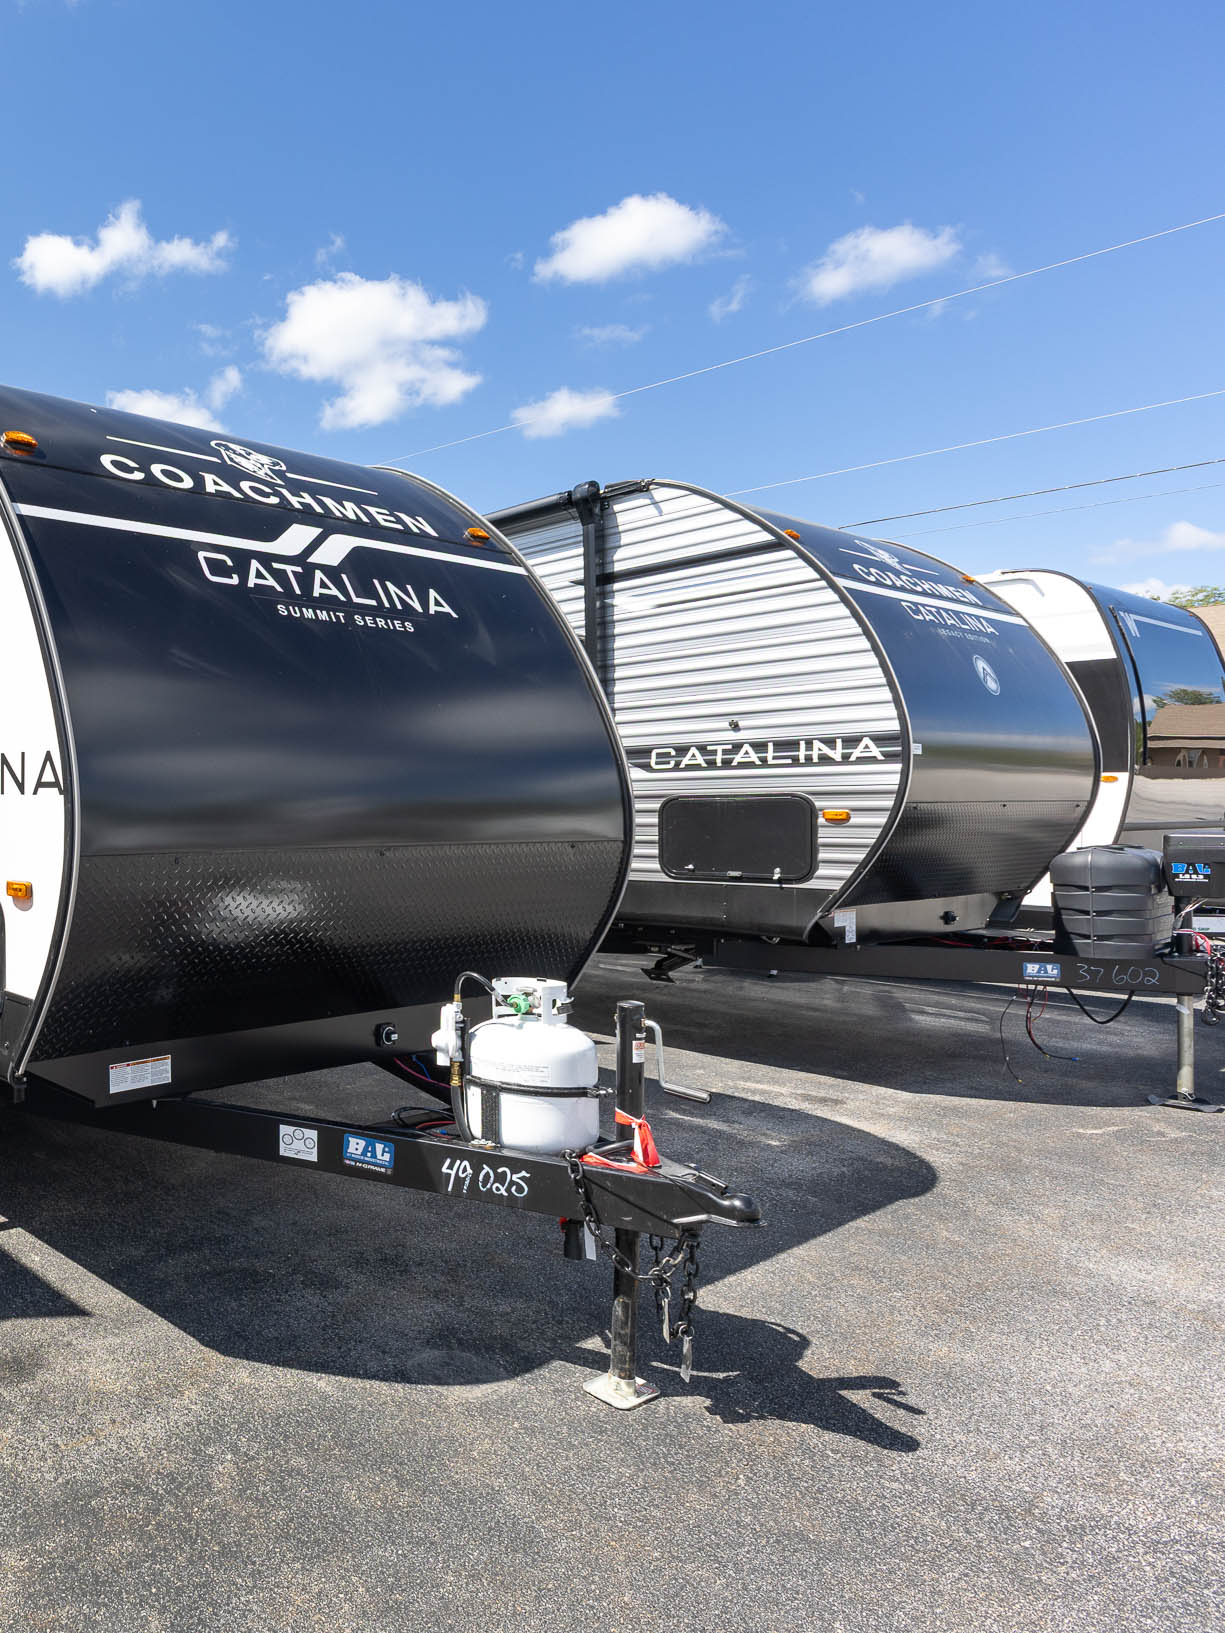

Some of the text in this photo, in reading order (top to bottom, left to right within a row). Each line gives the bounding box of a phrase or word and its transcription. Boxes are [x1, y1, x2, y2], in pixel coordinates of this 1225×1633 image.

[100, 454, 439, 537] COACHMEN
[197, 551, 459, 618] CATALINA
[853, 564, 983, 606] COACHMEN
[277, 604, 415, 632] SUMMIT SERIES
[900, 601, 999, 635] CATALINA
[650, 736, 885, 770] CATALINA
